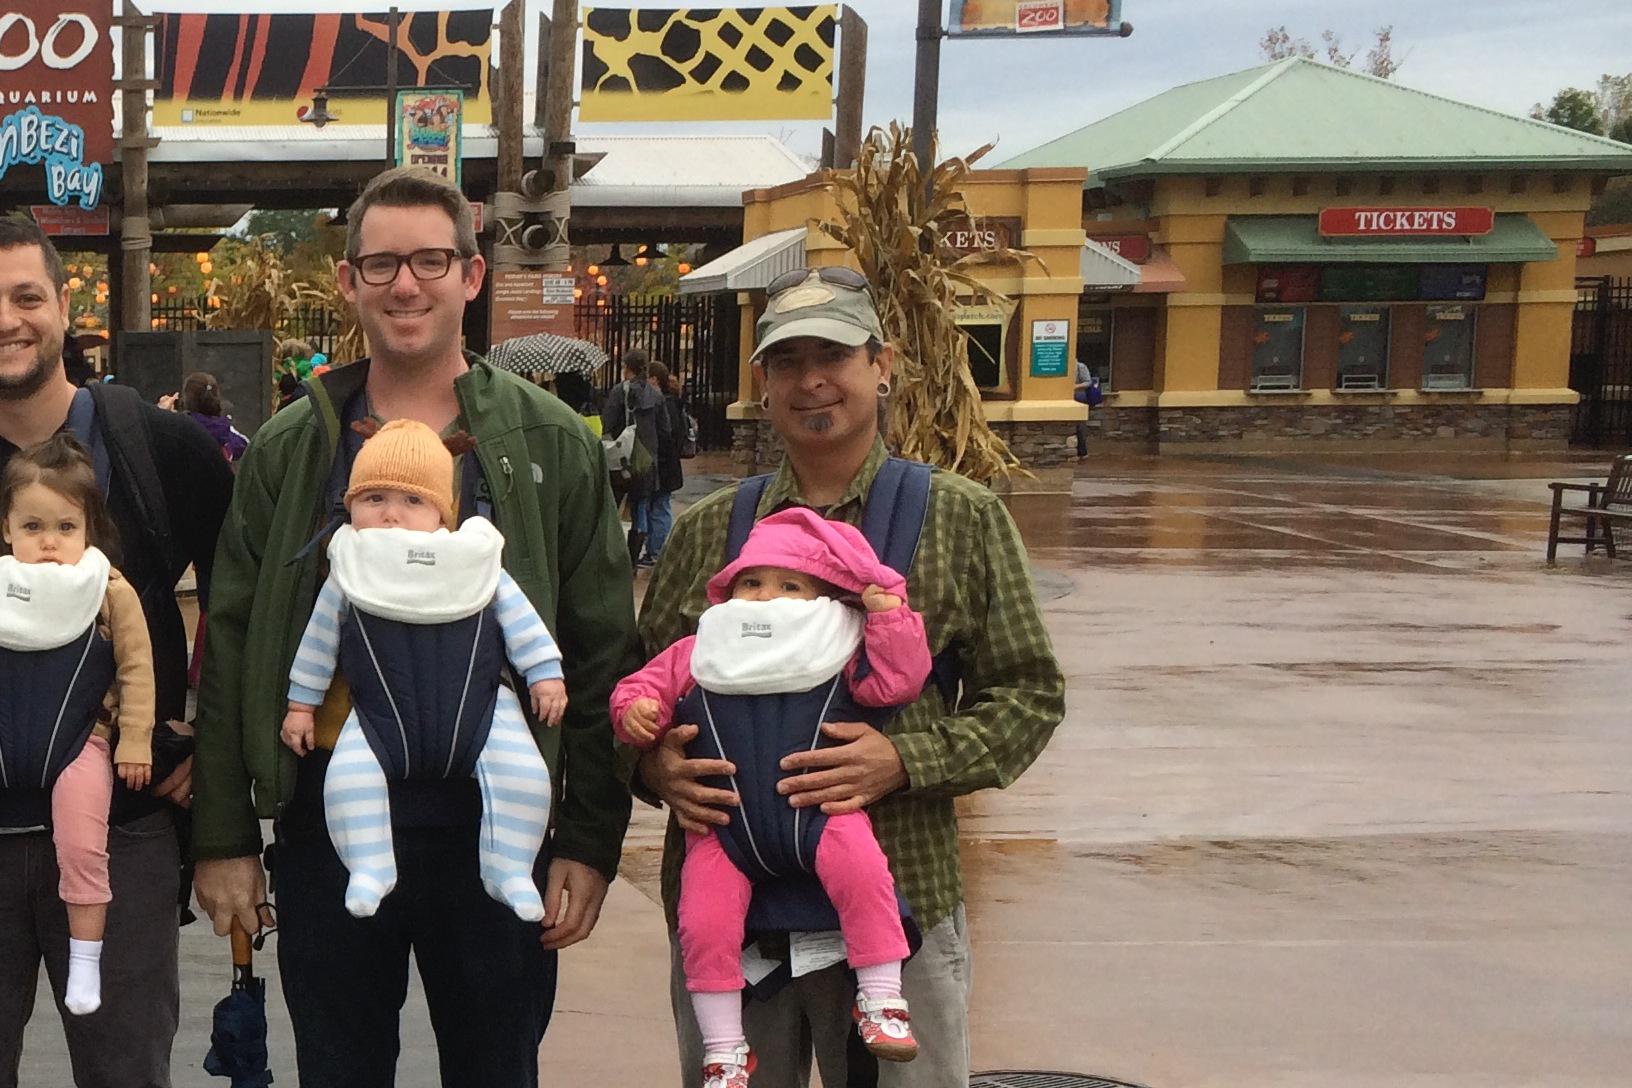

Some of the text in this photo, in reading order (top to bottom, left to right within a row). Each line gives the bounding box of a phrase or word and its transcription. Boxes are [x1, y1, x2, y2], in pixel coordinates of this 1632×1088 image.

[195, 109, 241, 117] Nationwide
[1355, 211, 1456, 230] TICKETS
[940, 230, 996, 248] KETS
